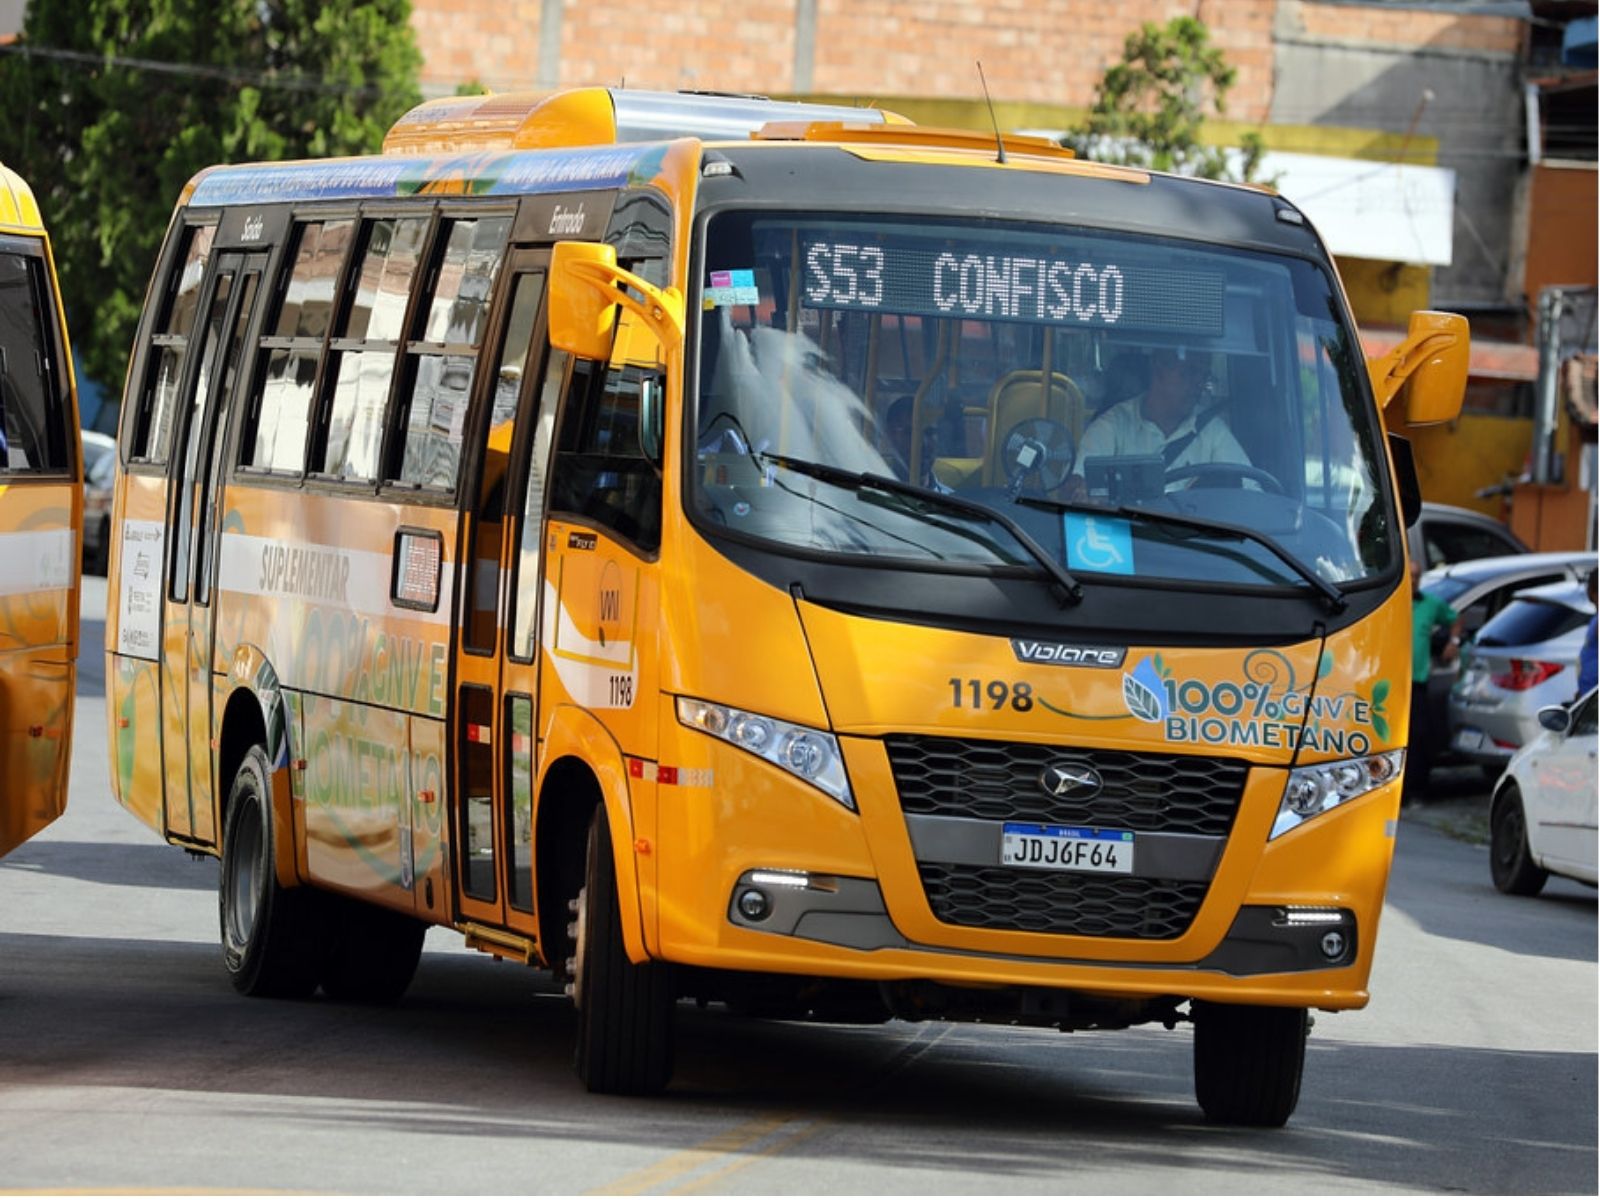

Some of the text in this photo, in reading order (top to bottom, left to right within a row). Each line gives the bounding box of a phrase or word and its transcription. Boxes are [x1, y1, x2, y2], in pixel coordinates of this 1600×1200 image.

[806, 243, 1124, 323] S53 CONFISCO
[259, 544, 350, 602] SUPLEMENTAR
[1018, 641, 1119, 664] Volare
[428, 643, 447, 716] E
[609, 675, 633, 707] 1198
[948, 677, 1034, 714] 1198
[1163, 678, 1370, 724] 100% GNV E
[1165, 715, 1371, 758] BIOMETANO
[1014, 837, 1118, 869] JDJ6F64
